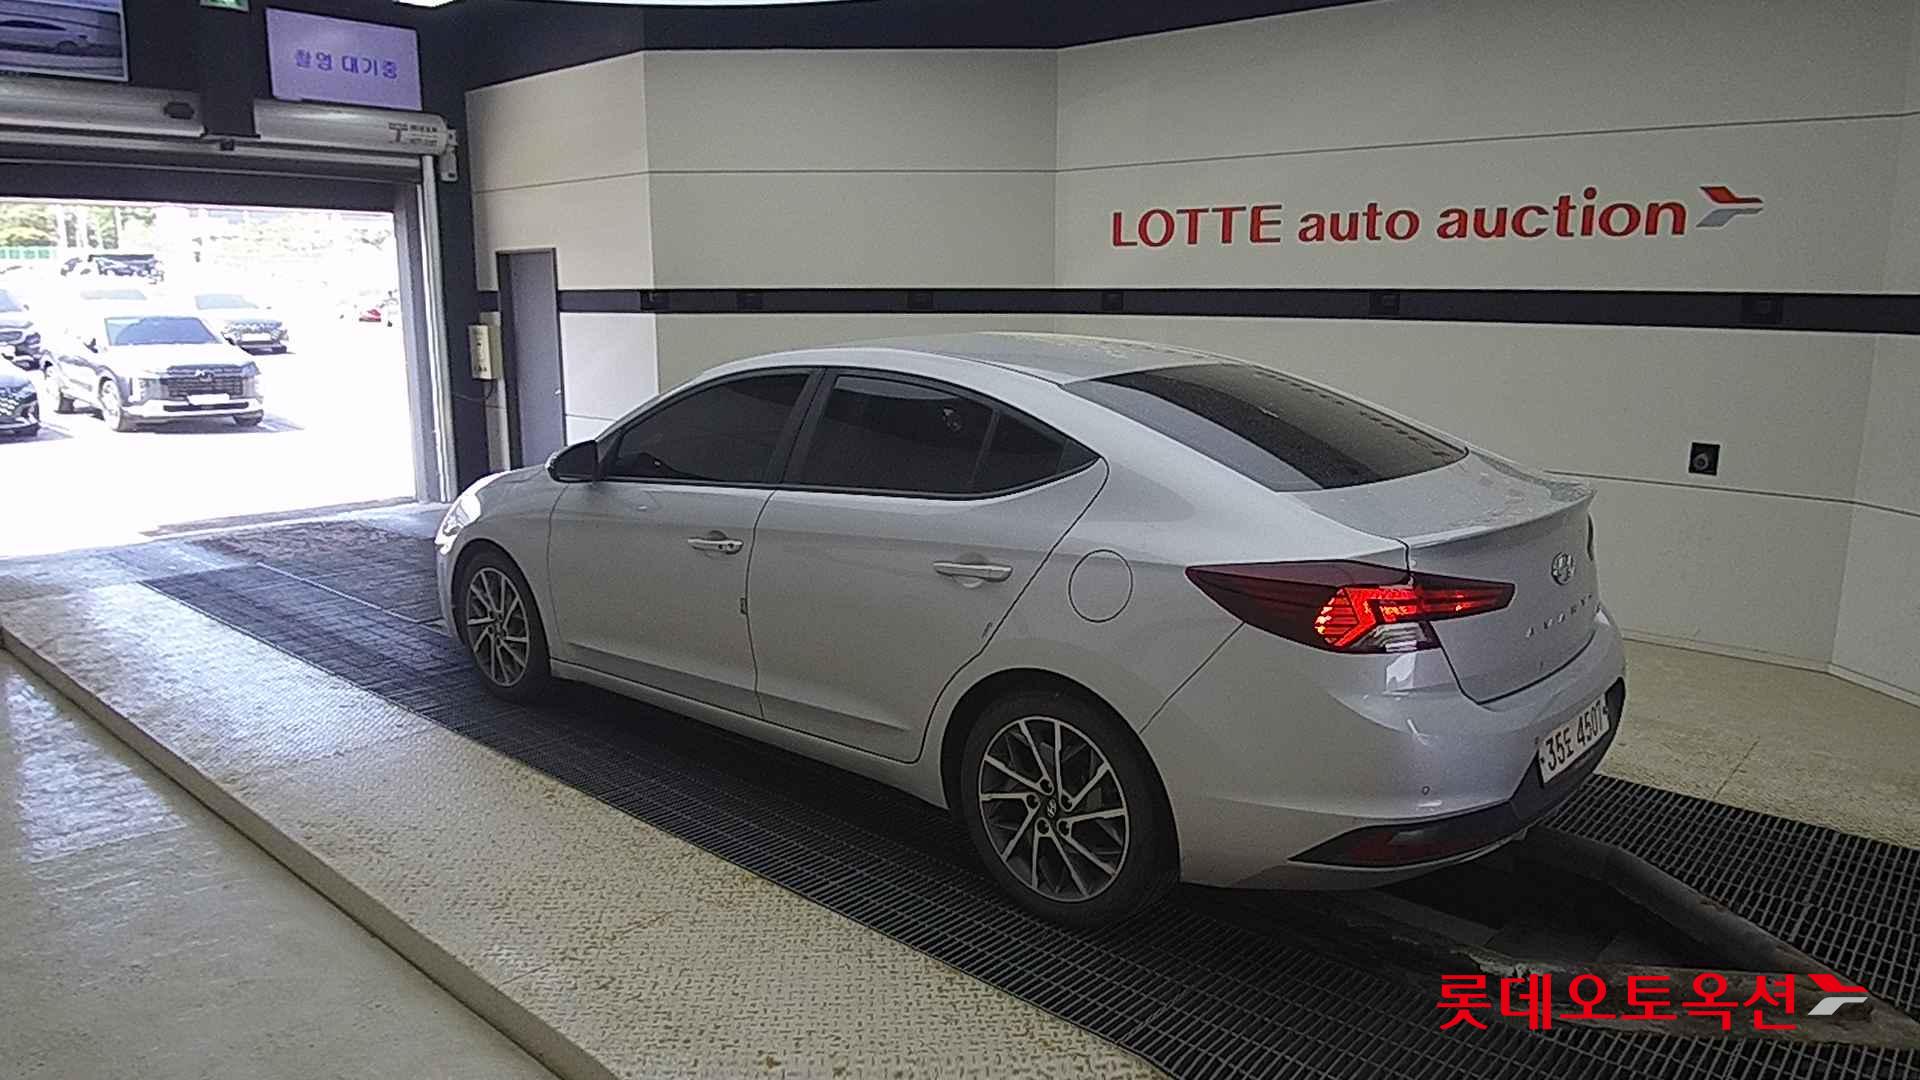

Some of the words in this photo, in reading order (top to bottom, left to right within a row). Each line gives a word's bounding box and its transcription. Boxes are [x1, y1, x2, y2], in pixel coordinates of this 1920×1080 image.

[342, 55, 397, 79] 대기중
[1112, 204, 1282, 247] LOTTE
[1299, 203, 1420, 242] auto
[1436, 187, 1687, 240] auction
